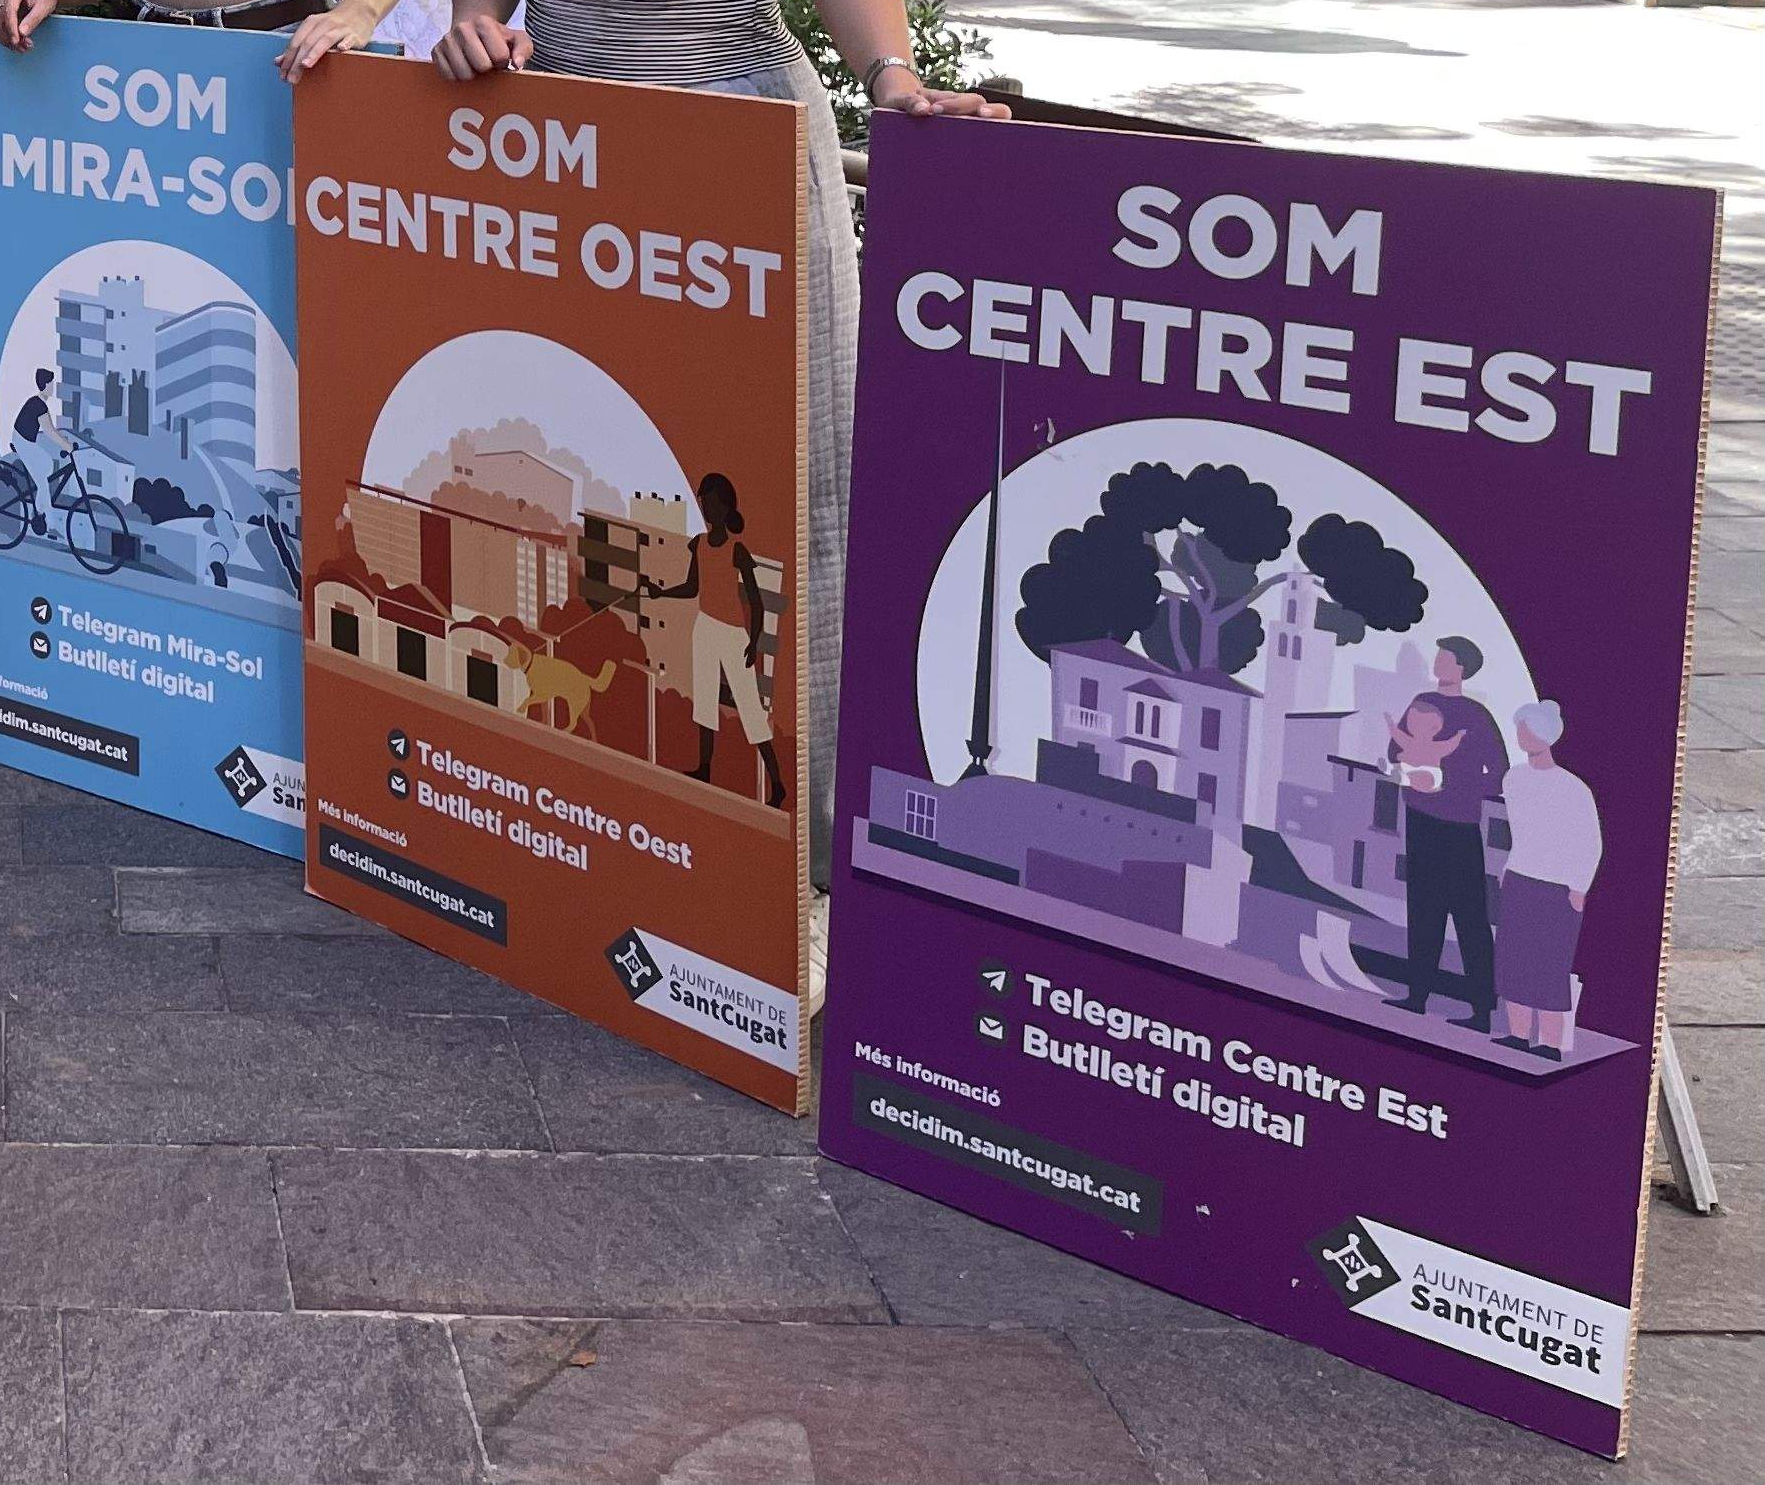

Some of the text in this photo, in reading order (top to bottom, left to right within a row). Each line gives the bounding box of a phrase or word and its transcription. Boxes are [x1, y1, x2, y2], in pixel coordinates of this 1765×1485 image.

[83, 64, 227, 135] SOM
[447, 107, 597, 189] SOM
[305, 175, 782, 318] CENTRE OEST
[1112, 184, 1384, 296] SOM
[895, 271, 1653, 457] CENTRE EST
[58, 604, 264, 680] Telegram Mira-Sol
[58, 641, 214, 703] Butlletí digital
[318, 798, 408, 848] Més informació
[416, 739, 693, 870] Telegram Centre Oest
[416, 781, 589, 871] Butlletí digital
[329, 841, 495, 929] decidim.santcugat.cat
[668, 979, 788, 1051] SantCugat
[669, 963, 787, 1027] AJUNTAMENT DE
[854, 1041, 1002, 1109] Més informació
[1022, 1024, 1307, 1148] Butlletí digital
[1025, 973, 1448, 1141] Telegram Centre Est
[869, 1095, 1141, 1215] decidim.santcugat.cat
[1410, 1285, 1603, 1375] SantCugat
[1412, 1262, 1606, 1346] AJUNTAMENT DE
